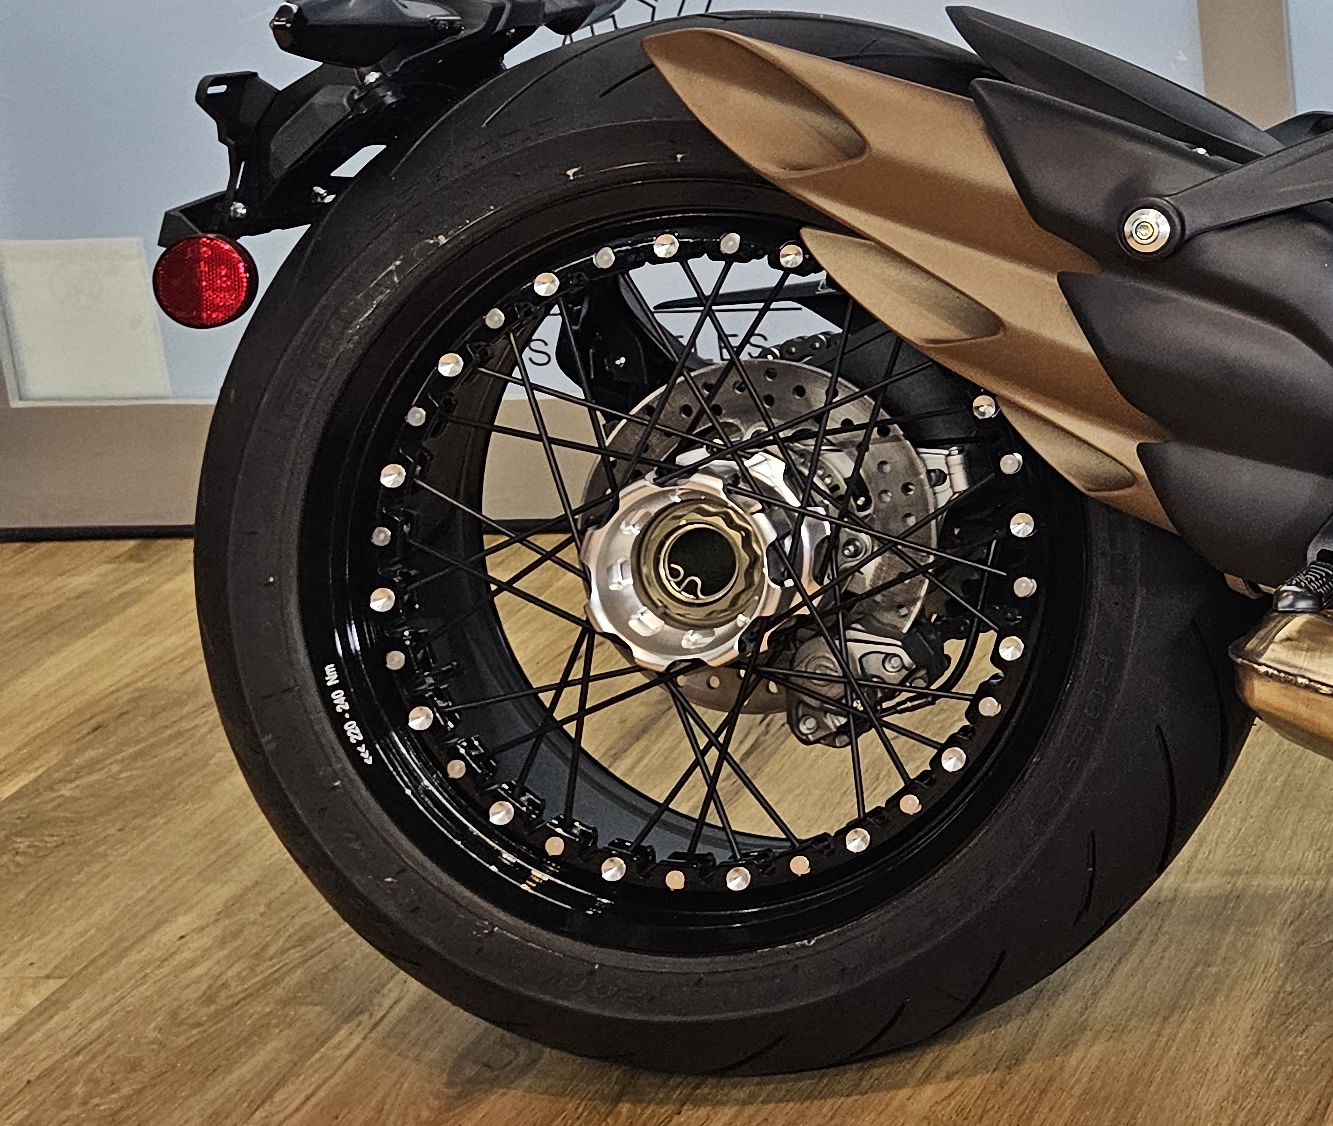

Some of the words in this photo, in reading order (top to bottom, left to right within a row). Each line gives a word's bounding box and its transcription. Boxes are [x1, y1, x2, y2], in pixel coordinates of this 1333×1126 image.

[324, 663, 340, 686] Nm
[330, 689, 350, 713] 240
[343, 720, 364, 744] 220
